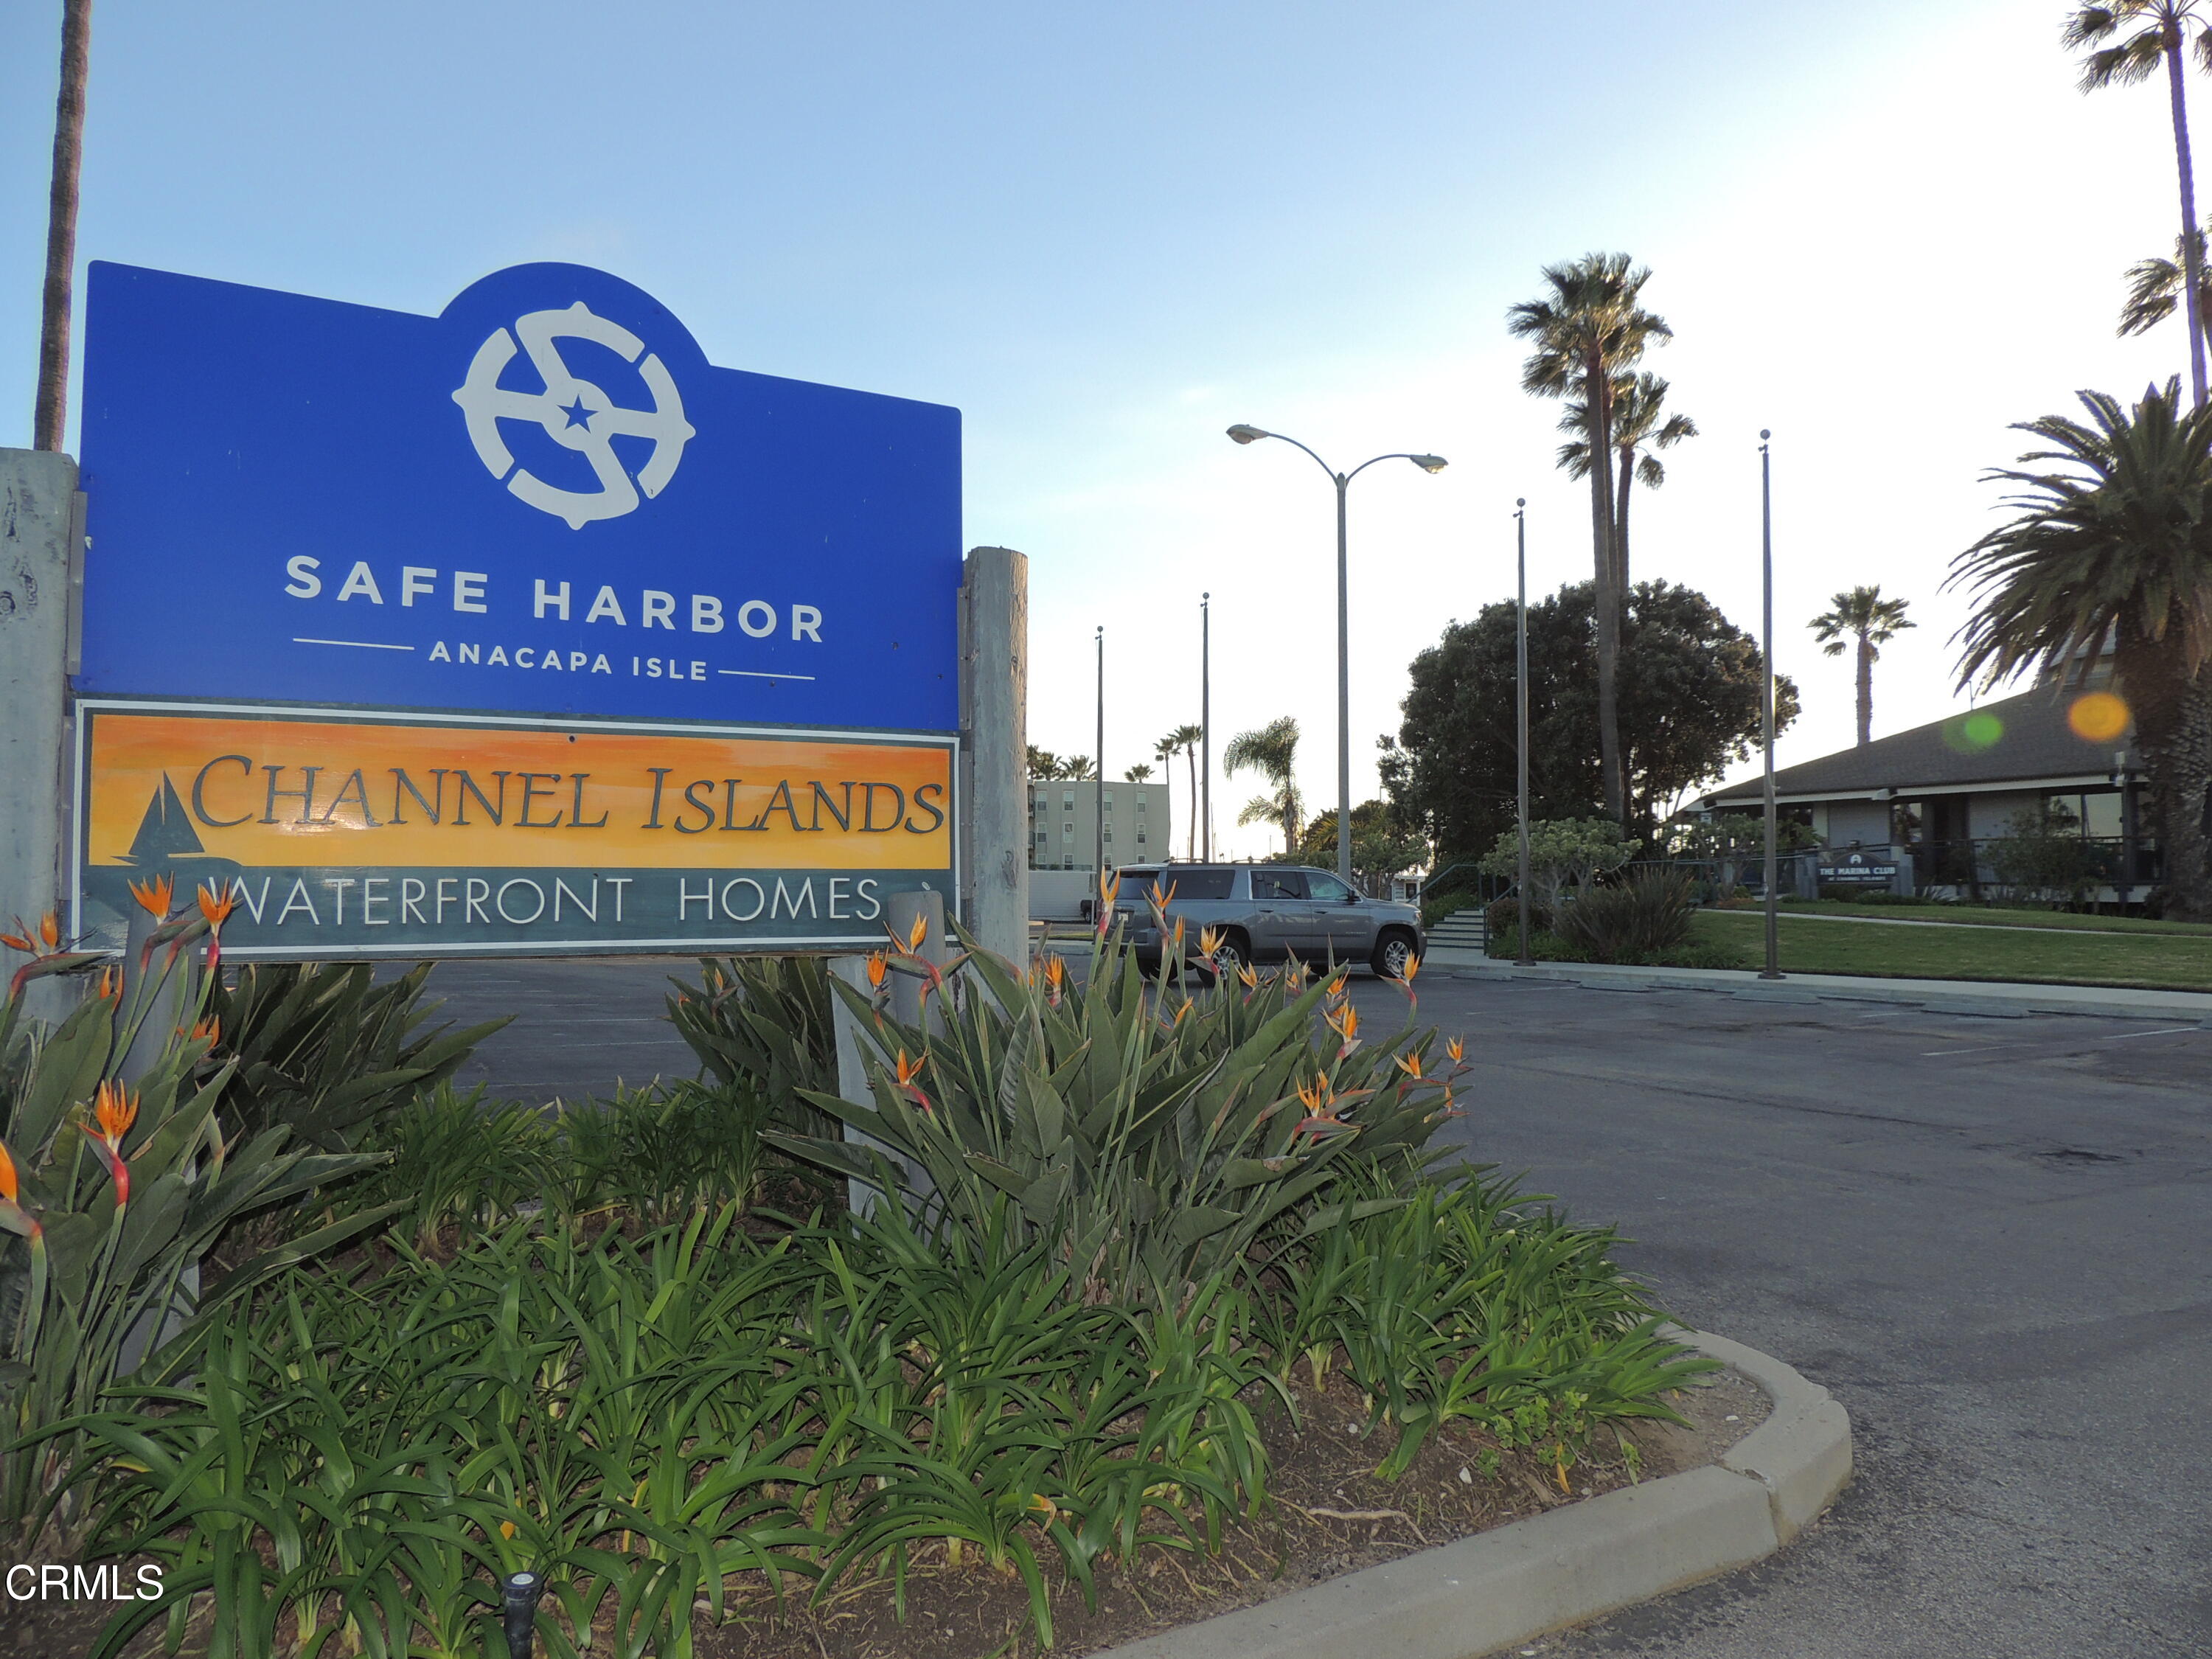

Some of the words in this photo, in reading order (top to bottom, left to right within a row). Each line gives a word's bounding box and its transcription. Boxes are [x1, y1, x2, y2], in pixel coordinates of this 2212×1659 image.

[285, 555, 487, 613] SAFE
[534, 579, 822, 643] HARBOR
[428, 641, 612, 675] ANACAPA
[633, 656, 706, 681] ISLE
[191, 754, 609, 828] CHANNEL
[641, 768, 945, 835] ISLANDS
[1837, 867, 1871, 875] MARINA
[1874, 866, 1896, 874] CLUB
[208, 875, 633, 925] WATERFRONT
[680, 877, 880, 921] HOMES
